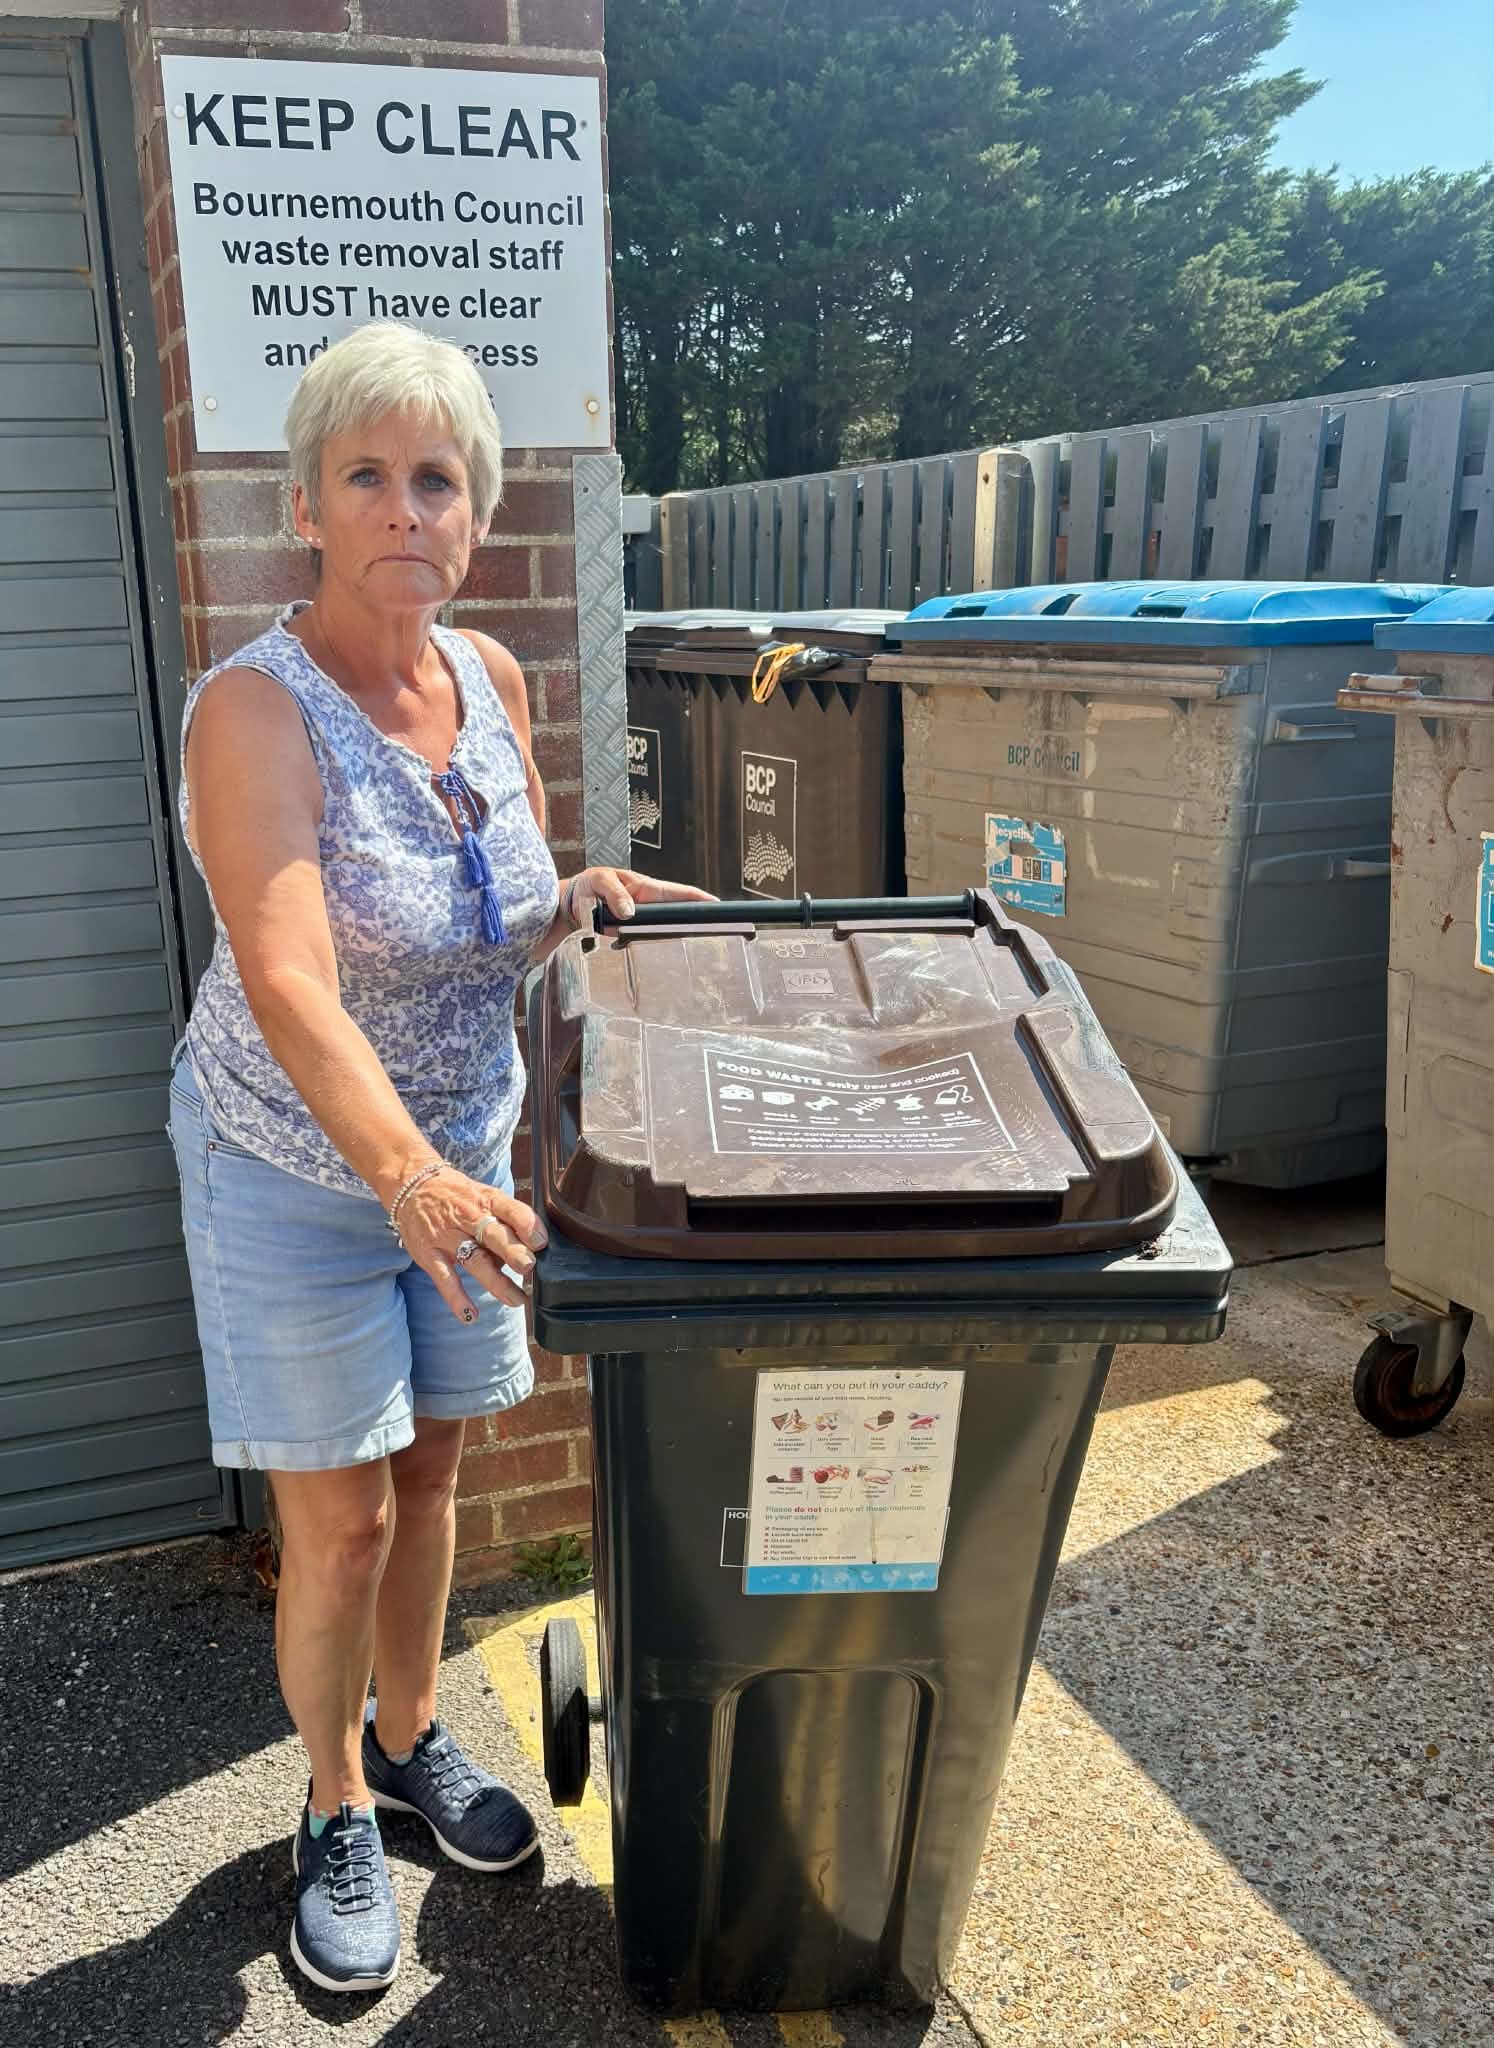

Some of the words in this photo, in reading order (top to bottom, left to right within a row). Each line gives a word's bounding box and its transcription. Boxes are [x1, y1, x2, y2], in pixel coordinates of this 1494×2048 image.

[184, 92, 355, 152] KEEP
[376, 101, 581, 161] CLEAR
[193, 182, 444, 222] Bournemouth
[455, 191, 584, 226] Council
[222, 235, 330, 267] waste
[340, 238, 479, 269] removal
[488, 240, 564, 271] staff
[252, 284, 358, 317] MUST
[368, 286, 450, 318] have
[460, 288, 542, 319] clear
[463, 343, 539, 367] cess
[627, 735, 648, 761] BCP
[1008, 745, 1030, 767] BCP
[745, 763, 776, 796] BCP
[745, 793, 776, 817] Council
[717, 1060, 763, 1076] FOOD
[766, 1069, 823, 1086] WASTE
[826, 1080, 859, 1091] only
[890, 1079, 912, 1088] and
[773, 1383, 801, 1391] What
[803, 1383, 824, 1391] can
[826, 1383, 846, 1392] you
[848, 1382, 866, 1392] put
[868, 1381, 879, 1389] in
[881, 1382, 905, 1391] your
[908, 1381, 948, 1392] caddy?
[766, 1505, 793, 1513] Please
[794, 1505, 805, 1513] do
[807, 1505, 822, 1513] not
